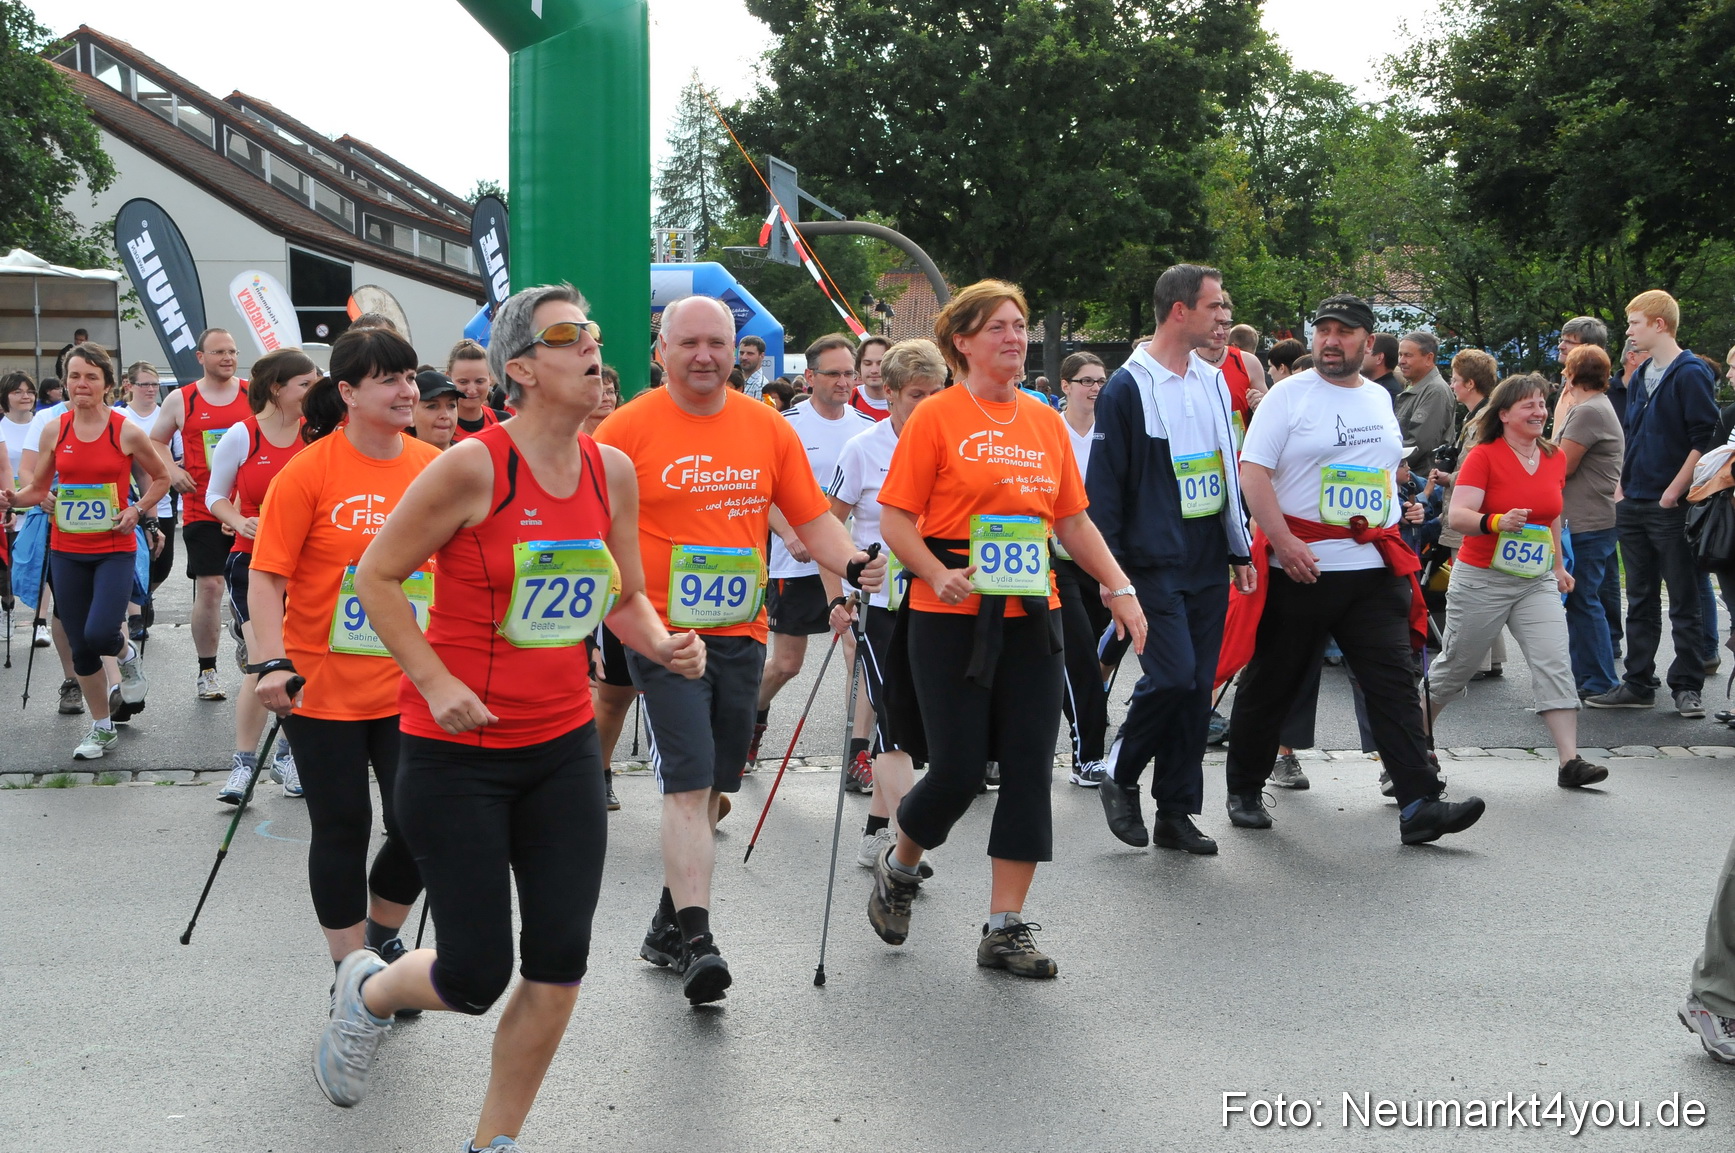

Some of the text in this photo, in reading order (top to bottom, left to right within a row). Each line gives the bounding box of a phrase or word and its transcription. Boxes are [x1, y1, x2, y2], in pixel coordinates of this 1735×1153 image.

[1347, 425, 1384, 433] EVANGELISCH
[1348, 437, 1382, 446] NEUMARKT
[977, 443, 1045, 461] Fischer
[986, 457, 1042, 469] AUTOMOBILE
[681, 465, 760, 485] Fischer
[1016, 475, 1028, 484] das
[690, 482, 757, 493] AUTOMOBILE
[1325, 485, 1383, 511] 1008
[61, 500, 106, 520] 729
[706, 500, 722, 511] und
[724, 498, 741, 507] das
[981, 542, 1040, 575] 983
[1502, 540, 1544, 565] 654
[991, 575, 1013, 583] Lydia
[680, 574, 747, 608] 949
[522, 577, 596, 620] 728
[690, 608, 721, 616] Thomas
[530, 621, 555, 631] Beate
[348, 633, 378, 642] Sabine
